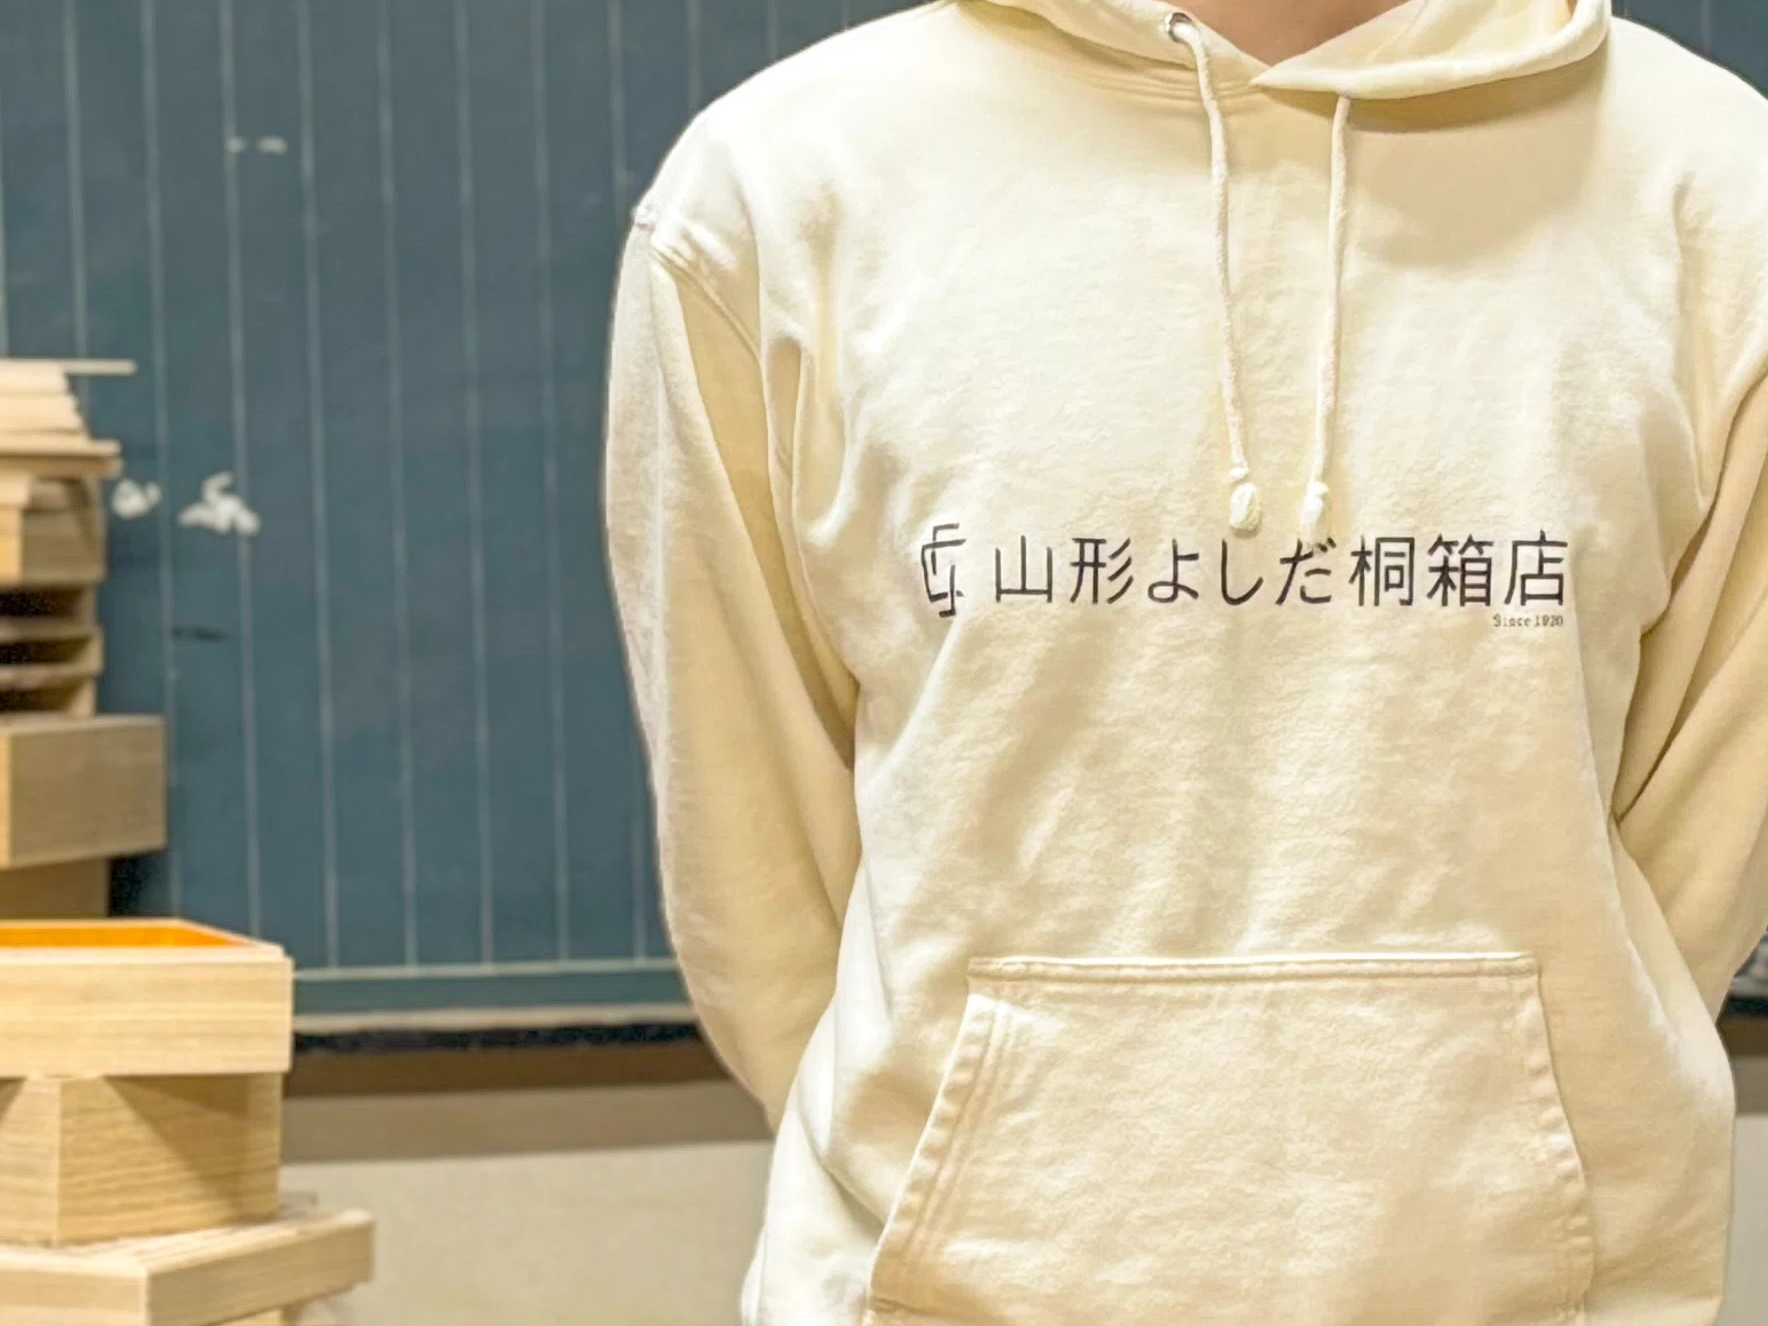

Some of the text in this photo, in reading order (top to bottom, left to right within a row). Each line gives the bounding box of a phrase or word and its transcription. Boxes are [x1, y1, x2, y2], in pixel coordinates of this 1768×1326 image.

[994, 529, 1569, 607] 山形よしだ桐箱店
